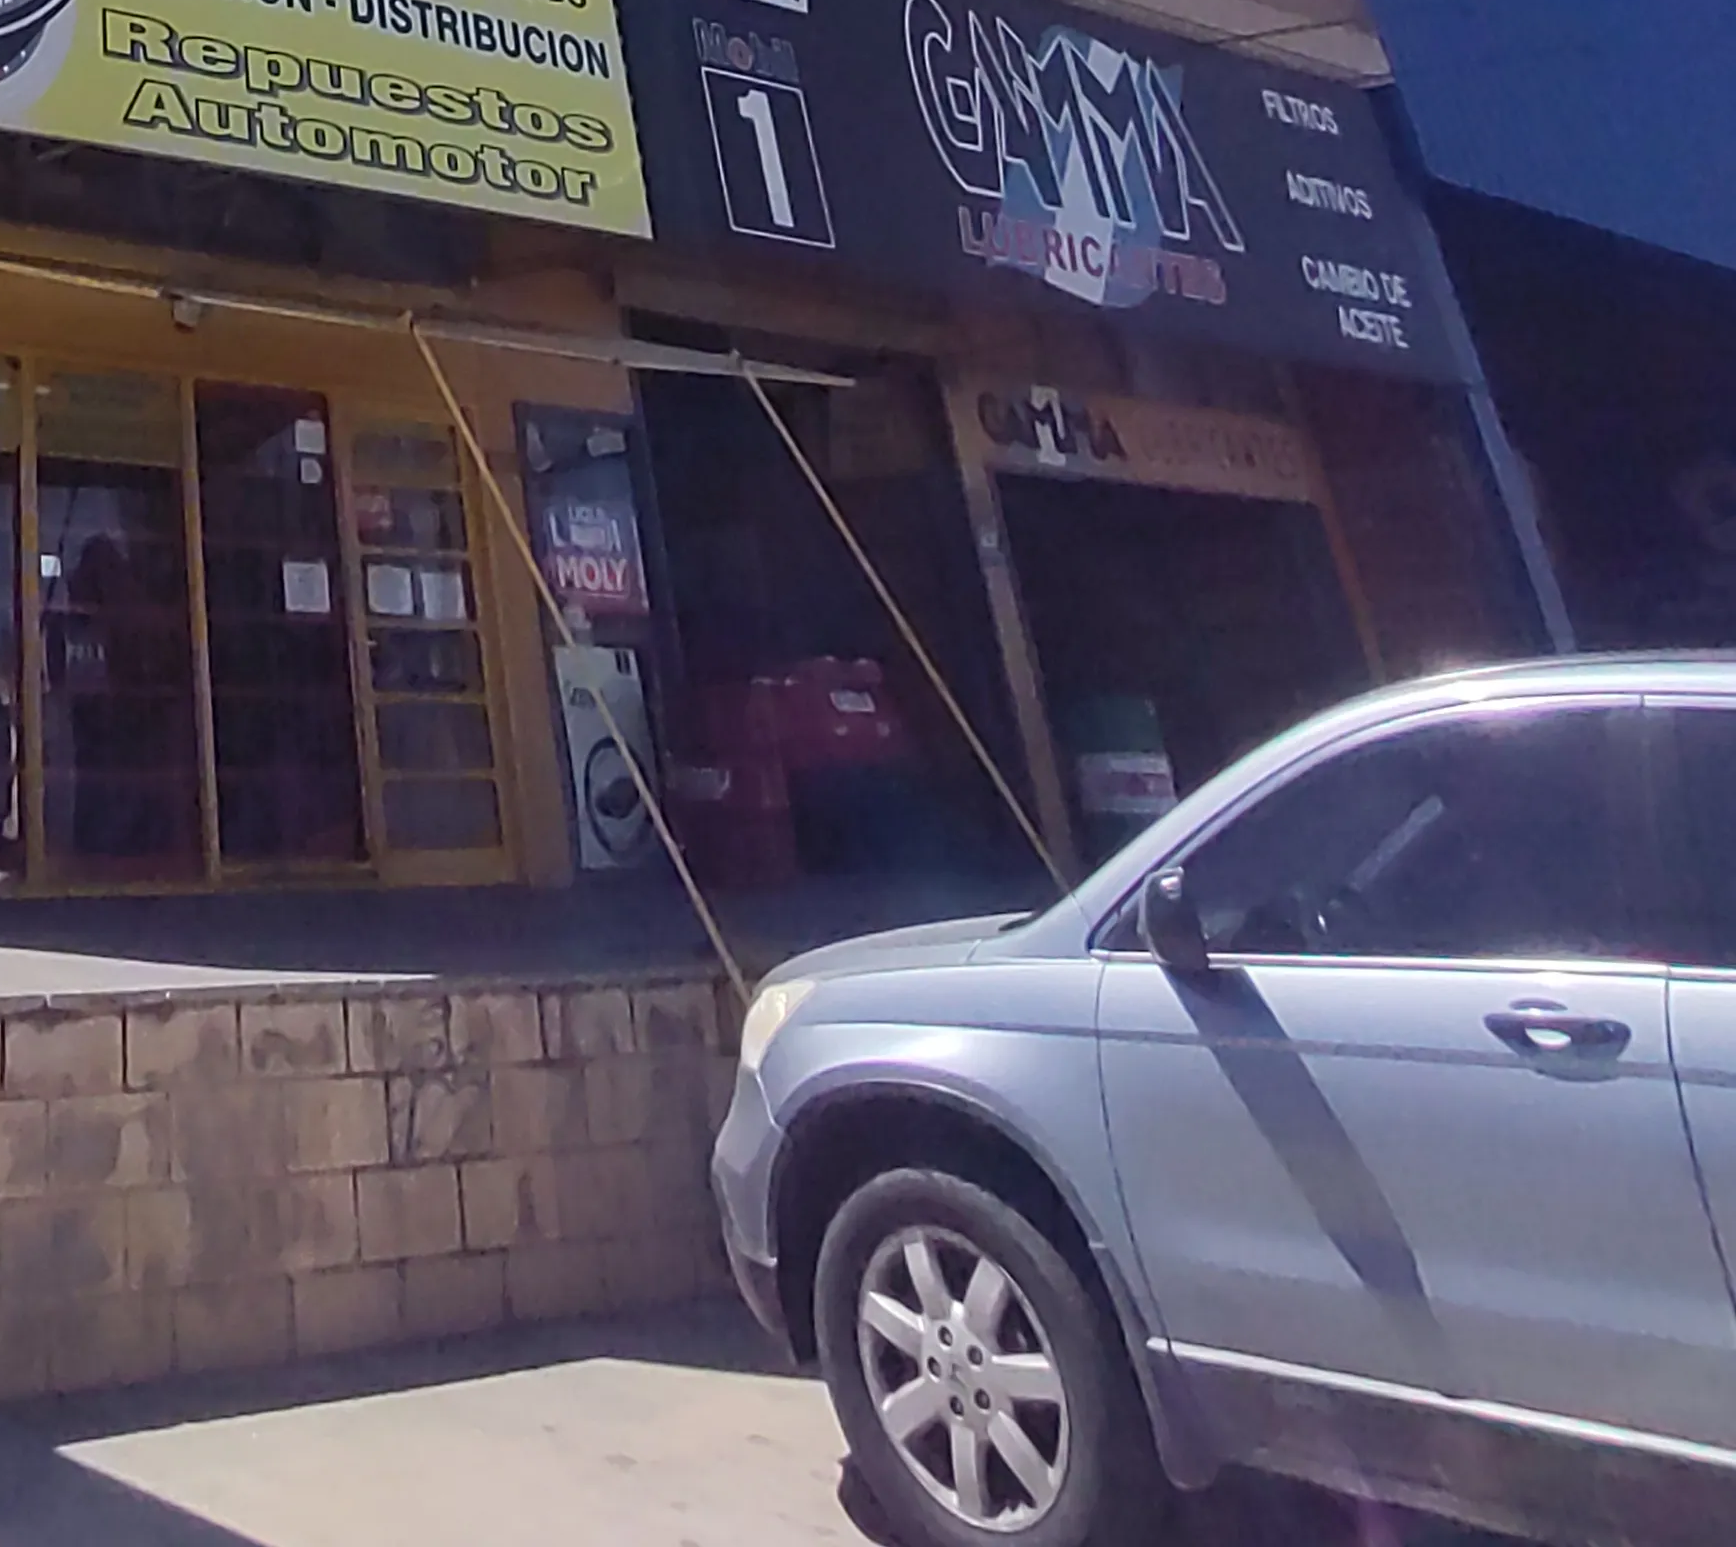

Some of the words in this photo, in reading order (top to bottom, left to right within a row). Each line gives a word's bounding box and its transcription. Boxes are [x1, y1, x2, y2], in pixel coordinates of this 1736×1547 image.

[102, 7, 614, 153] Repuestos
[1261, 89, 1340, 136] FILTROS
[123, 78, 599, 206] Automotor
[737, 89, 795, 228] 1
[1379, 271, 1413, 309] DE
[556, 555, 628, 592] MOLY
